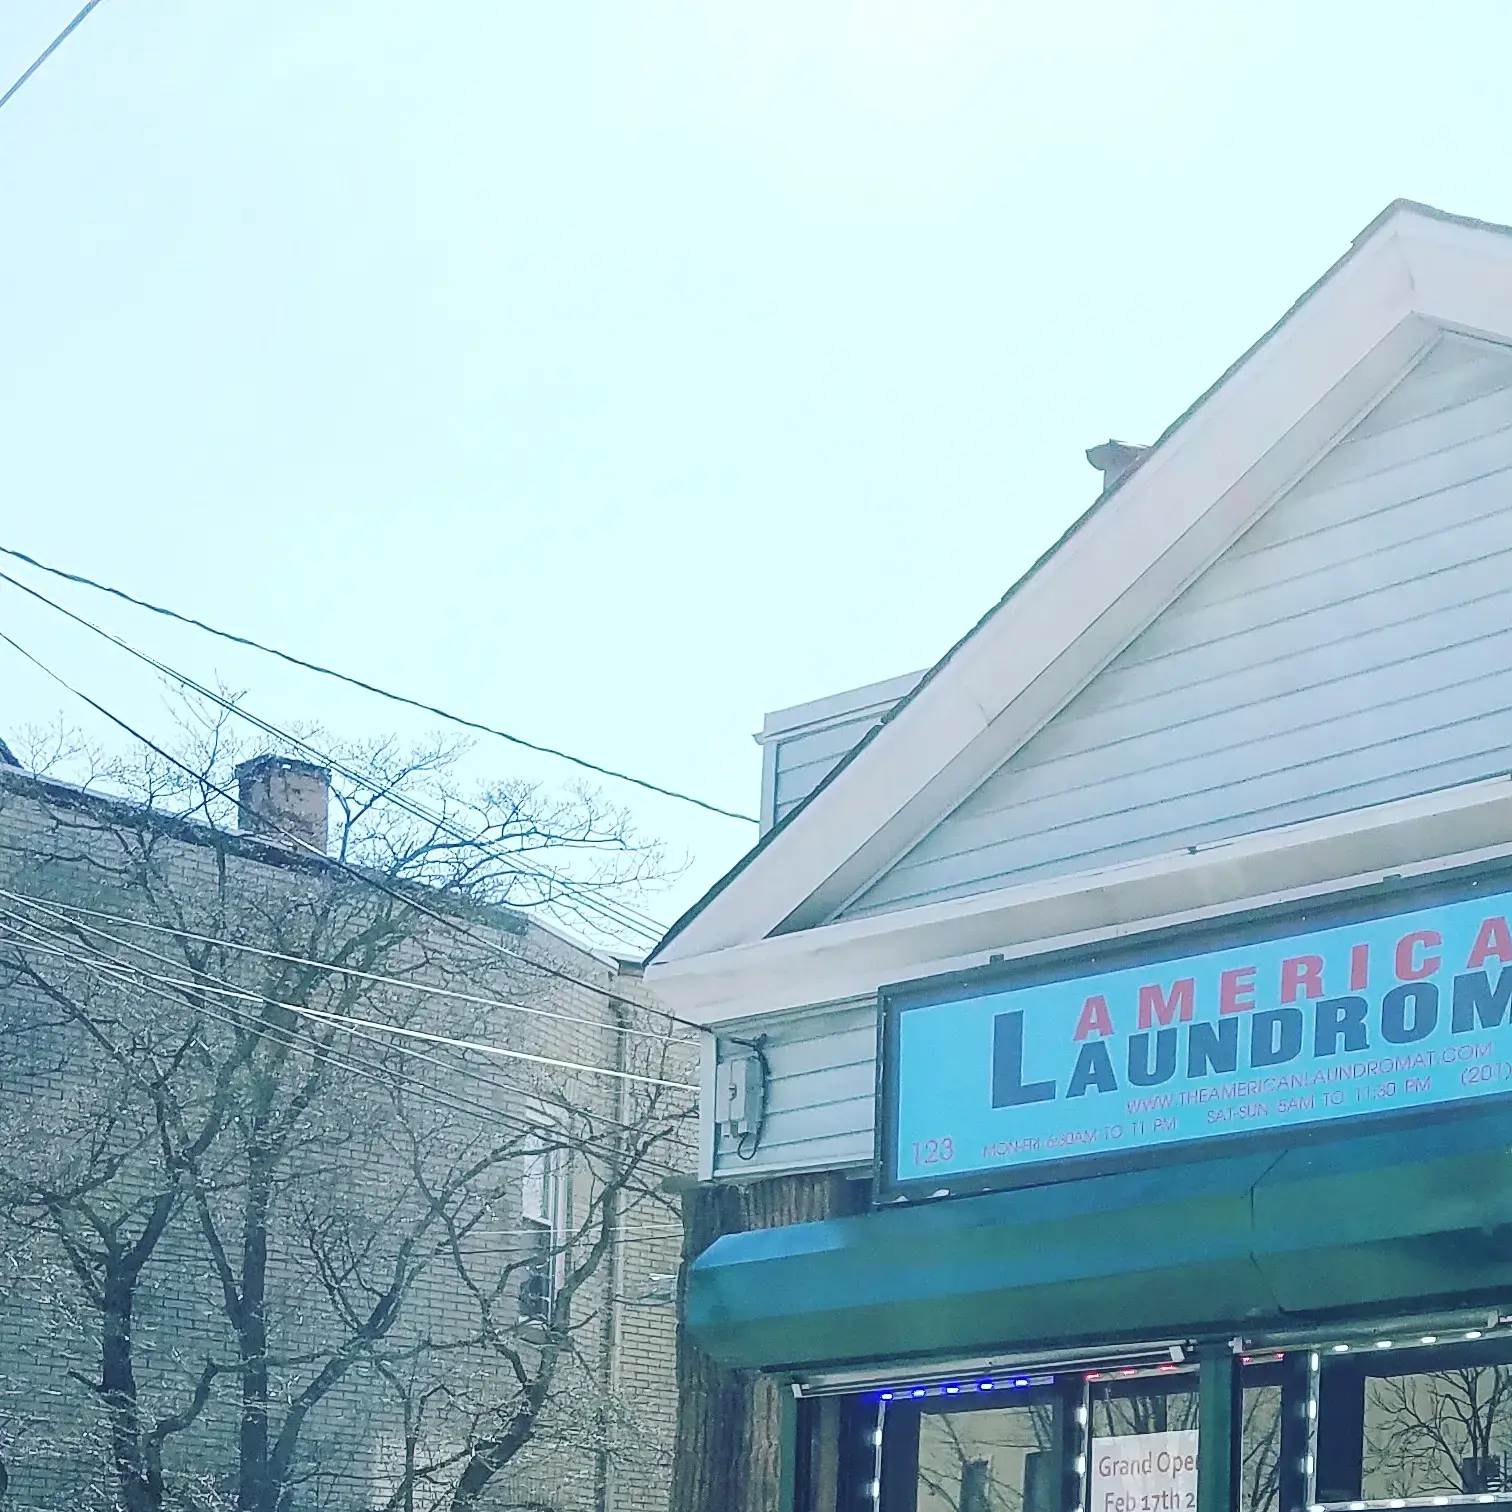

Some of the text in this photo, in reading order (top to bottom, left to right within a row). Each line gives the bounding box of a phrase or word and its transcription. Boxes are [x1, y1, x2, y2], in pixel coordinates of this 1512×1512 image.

[1126, 1042, 1493, 1115] WWW.THEAMERICANLAUNDROMAT.COM
[1103, 1124, 1123, 1140] TO
[1131, 1120, 1146, 1136] 11
[1153, 1116, 1177, 1133] PM
[1207, 1102, 1268, 1125] SAT-SUN
[1323, 1090, 1344, 1106] TO
[1405, 1075, 1432, 1094] PM
[912, 1138, 954, 1166] 123
[1099, 1451, 1199, 1479] Grand Ope
